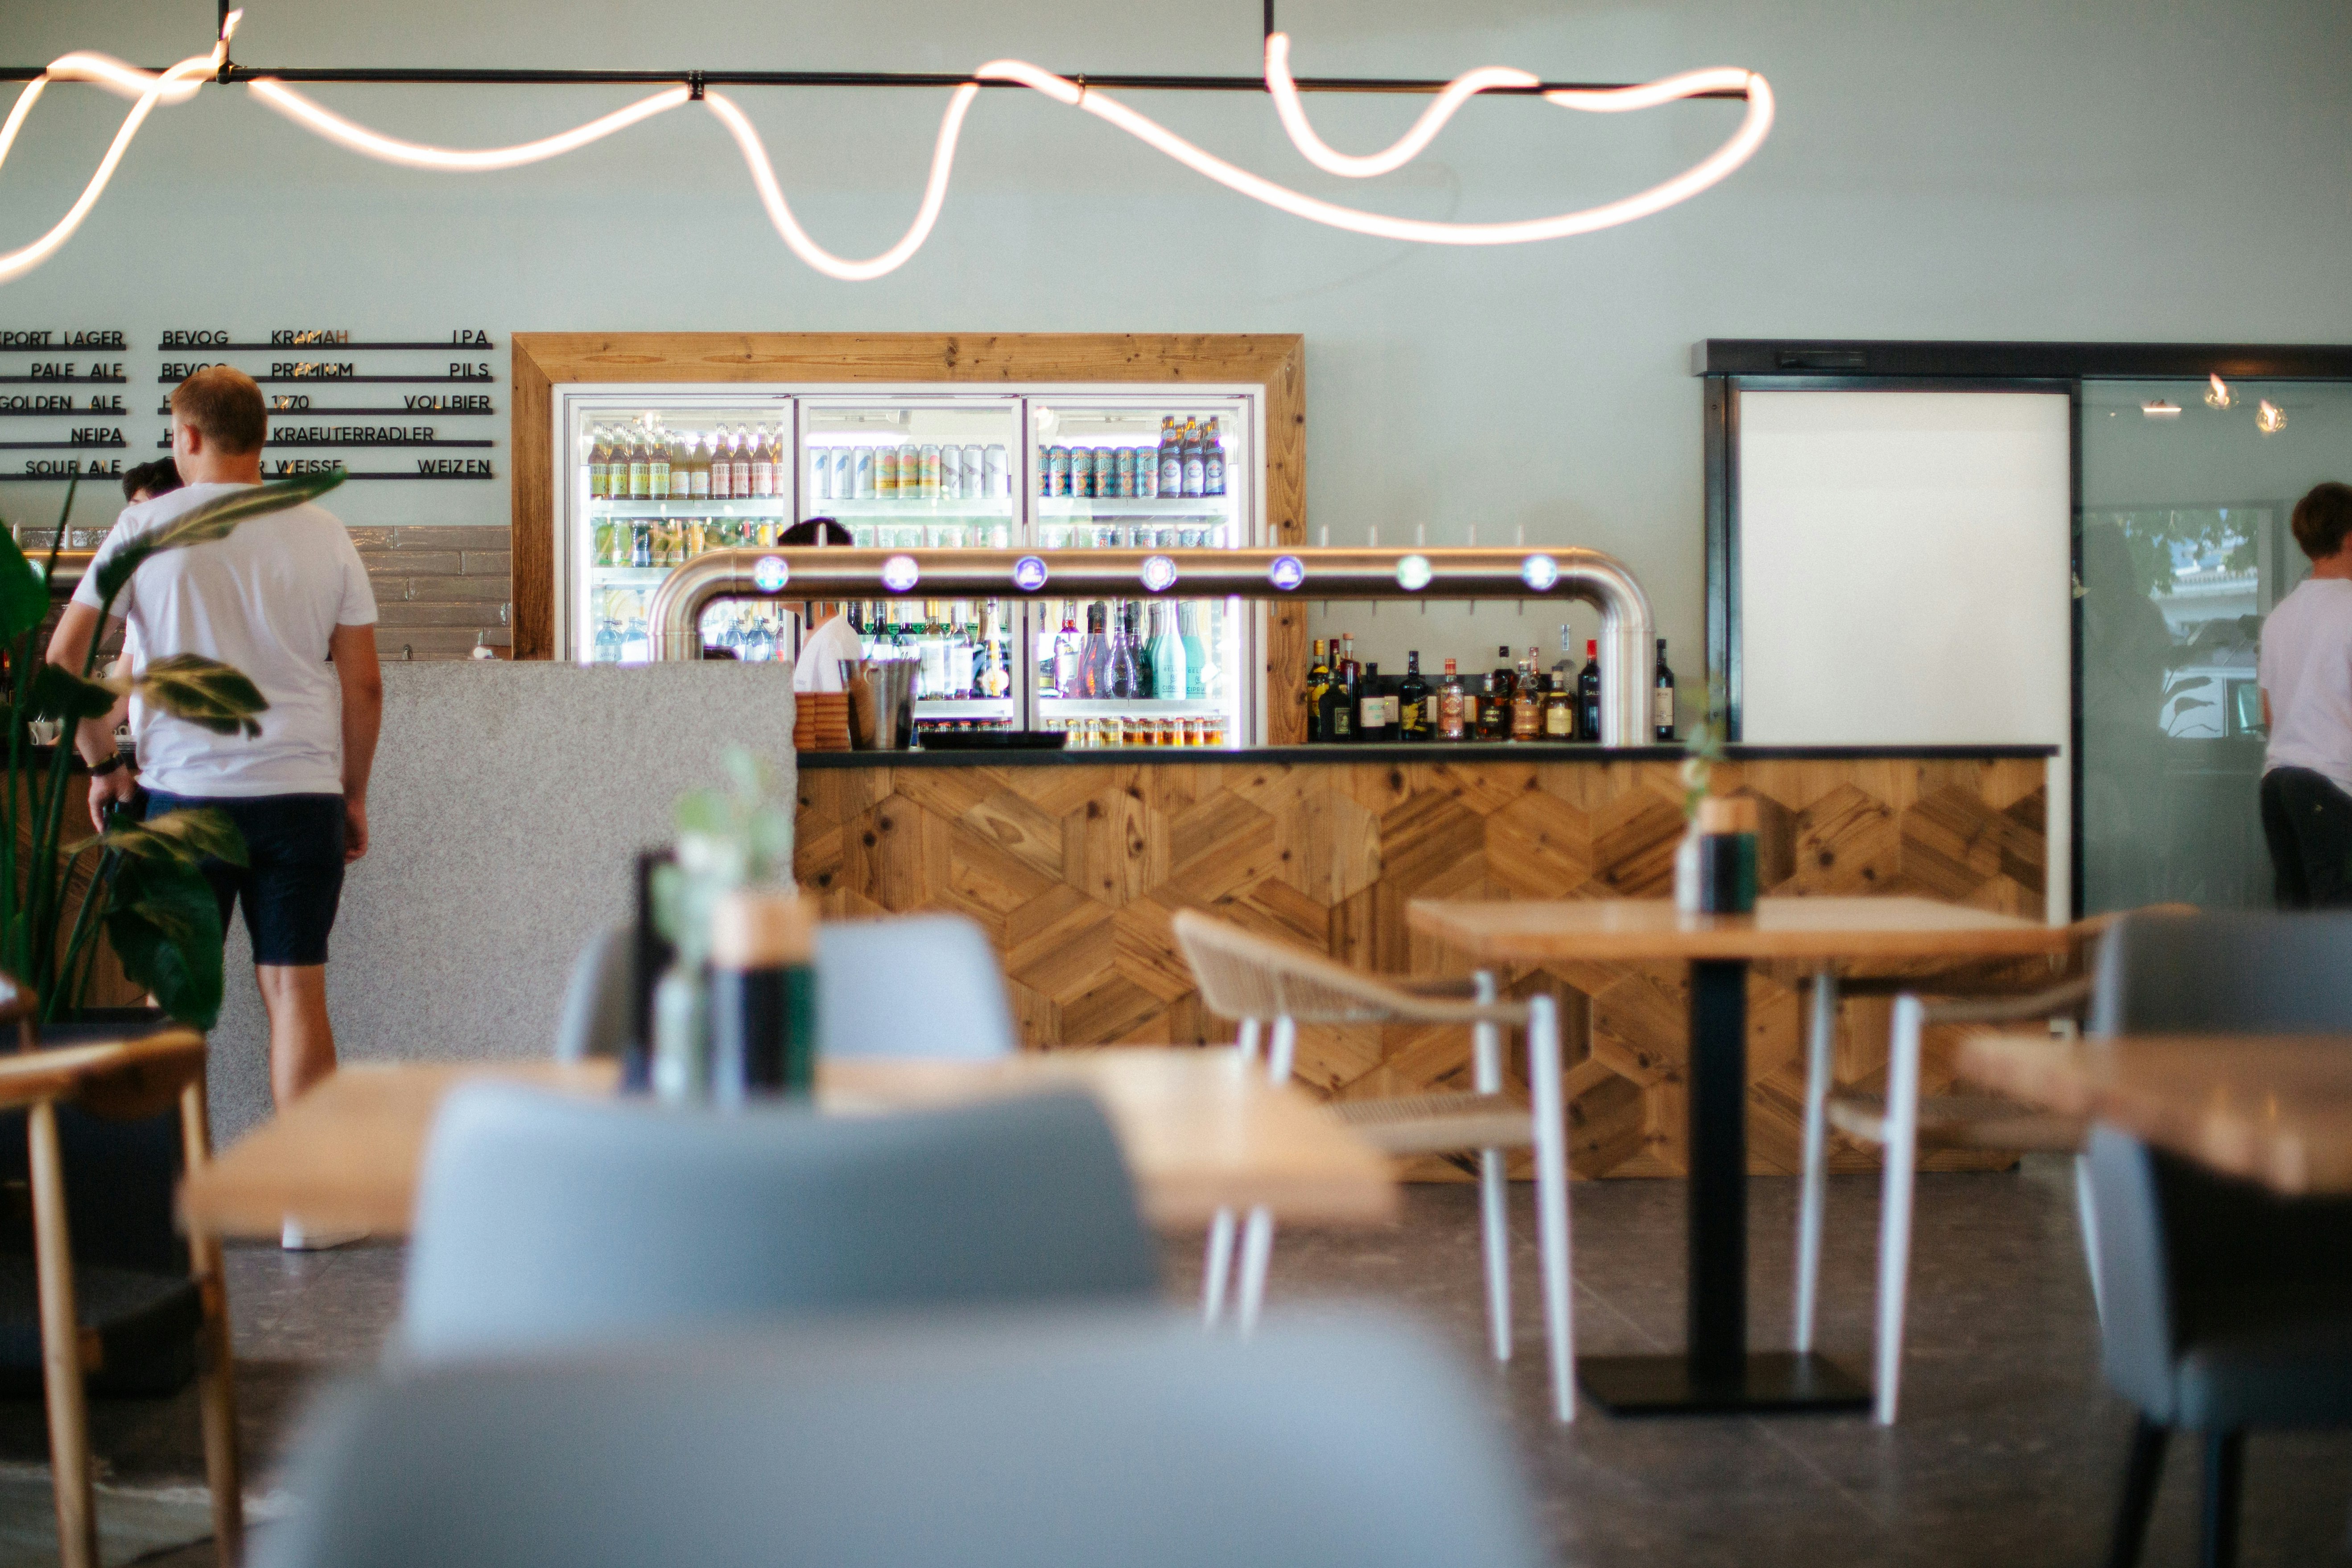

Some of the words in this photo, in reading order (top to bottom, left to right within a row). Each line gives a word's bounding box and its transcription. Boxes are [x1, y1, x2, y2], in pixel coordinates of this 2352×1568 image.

[0, 331, 51, 345] PORT
[65, 331, 122, 345] LAGER
[163, 330, 228, 344] BEVOG
[272, 330, 348, 344] KRAMAH
[31, 363, 74, 377] PALE
[91, 363, 122, 377] ALE
[162, 363, 227, 376] BEV
[272, 363, 353, 376] PREMIUM
[450, 363, 488, 376] PILS
[0, 396, 71, 409] GOLDEN
[90, 396, 121, 409] ALE
[272, 395, 309, 409] 1270
[404, 396, 489, 409] VOLLBIER
[71, 428, 123, 442] NEIPA
[273, 427, 434, 441] KRAEUTERRADLER
[26, 460, 77, 474] SOUR
[89, 460, 120, 474] ALE
[418, 460, 489, 473] WEIZEN
